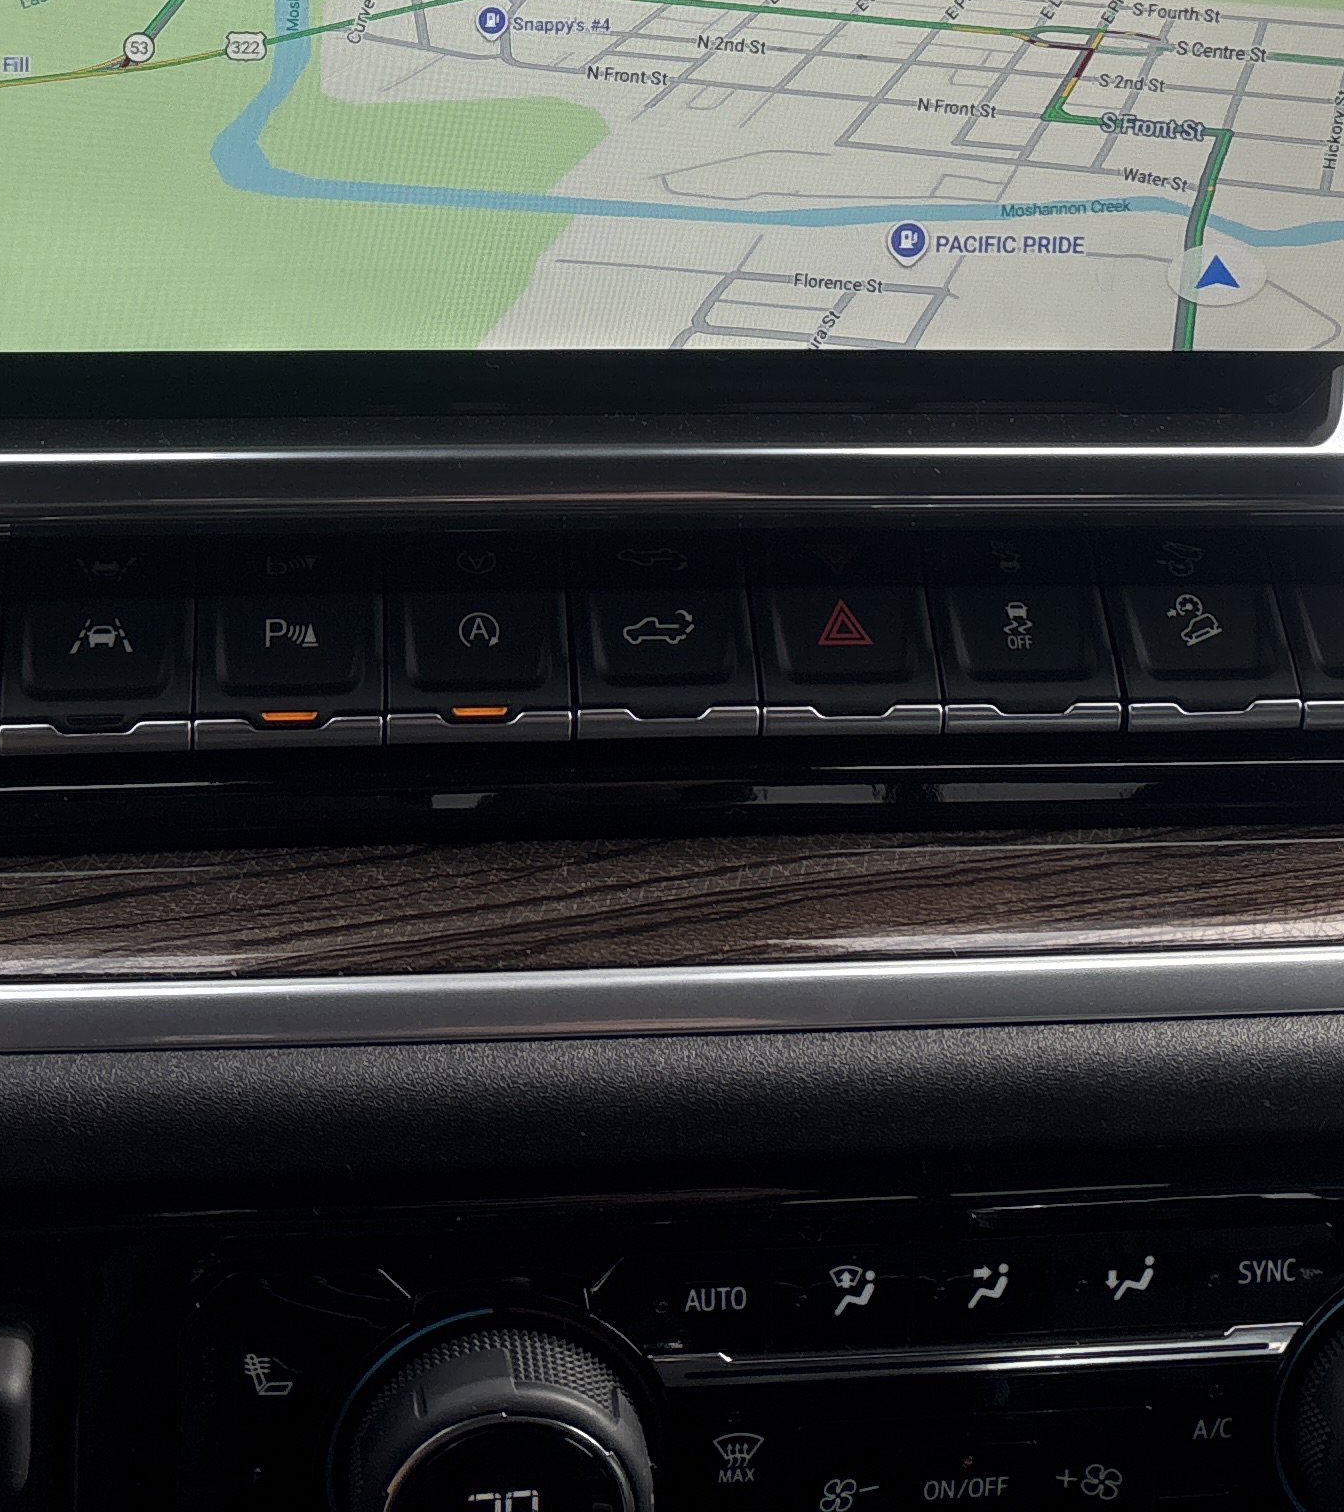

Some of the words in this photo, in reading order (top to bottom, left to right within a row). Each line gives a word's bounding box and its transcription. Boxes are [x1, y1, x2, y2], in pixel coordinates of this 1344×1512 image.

[944, 6, 959, 21] E
[1039, 6, 1056, 21] E
[1100, 10, 1115, 26] E
[1132, 3, 1144, 17] S
[1147, 4, 1200, 22] Fourth
[1202, 8, 1221, 24] St
[512, 16, 585, 34] Snappy's
[590, 17, 611, 33] #4
[130, 41, 150, 55] 53
[231, 40, 261, 55] 322
[696, 35, 711, 50] N
[713, 37, 746, 53] 2nd
[748, 39, 767, 55] St
[1175, 41, 1189, 56] S
[1191, 42, 1247, 60] Centre
[1248, 47, 1268, 63] St
[3, 56, 30, 73] Fill
[586, 66, 599, 81] N
[604, 67, 646, 85] Front
[647, 71, 669, 87] St
[1098, 73, 1111, 88] S
[1113, 75, 1145, 91] 2nd
[1147, 78, 1166, 93] St
[916, 98, 931, 113] N
[934, 98, 977, 116] Front
[978, 103, 997, 118] St
[1101, 112, 1118, 133] S
[1119, 113, 1177, 138] Front
[1179, 119, 1206, 140] St
[1122, 166, 1169, 189] Water
[1170, 176, 1188, 194] St
[1000, 199, 1087, 218] Moshannon
[1090, 198, 1131, 215] Creek
[935, 236, 1018, 255] PACIFIC
[1024, 236, 1085, 255] PRIDE
[793, 273, 864, 292] Florence
[865, 278, 884, 294] St
[821, 310, 842, 332] St
[1006, 634, 1033, 650] OFF
[1238, 1258, 1297, 1285] SYNC
[685, 1286, 748, 1312] AUTO
[1192, 1418, 1233, 1441] A/C
[718, 1468, 756, 1484] MAX
[923, 1477, 1009, 1501] ON/OFF
